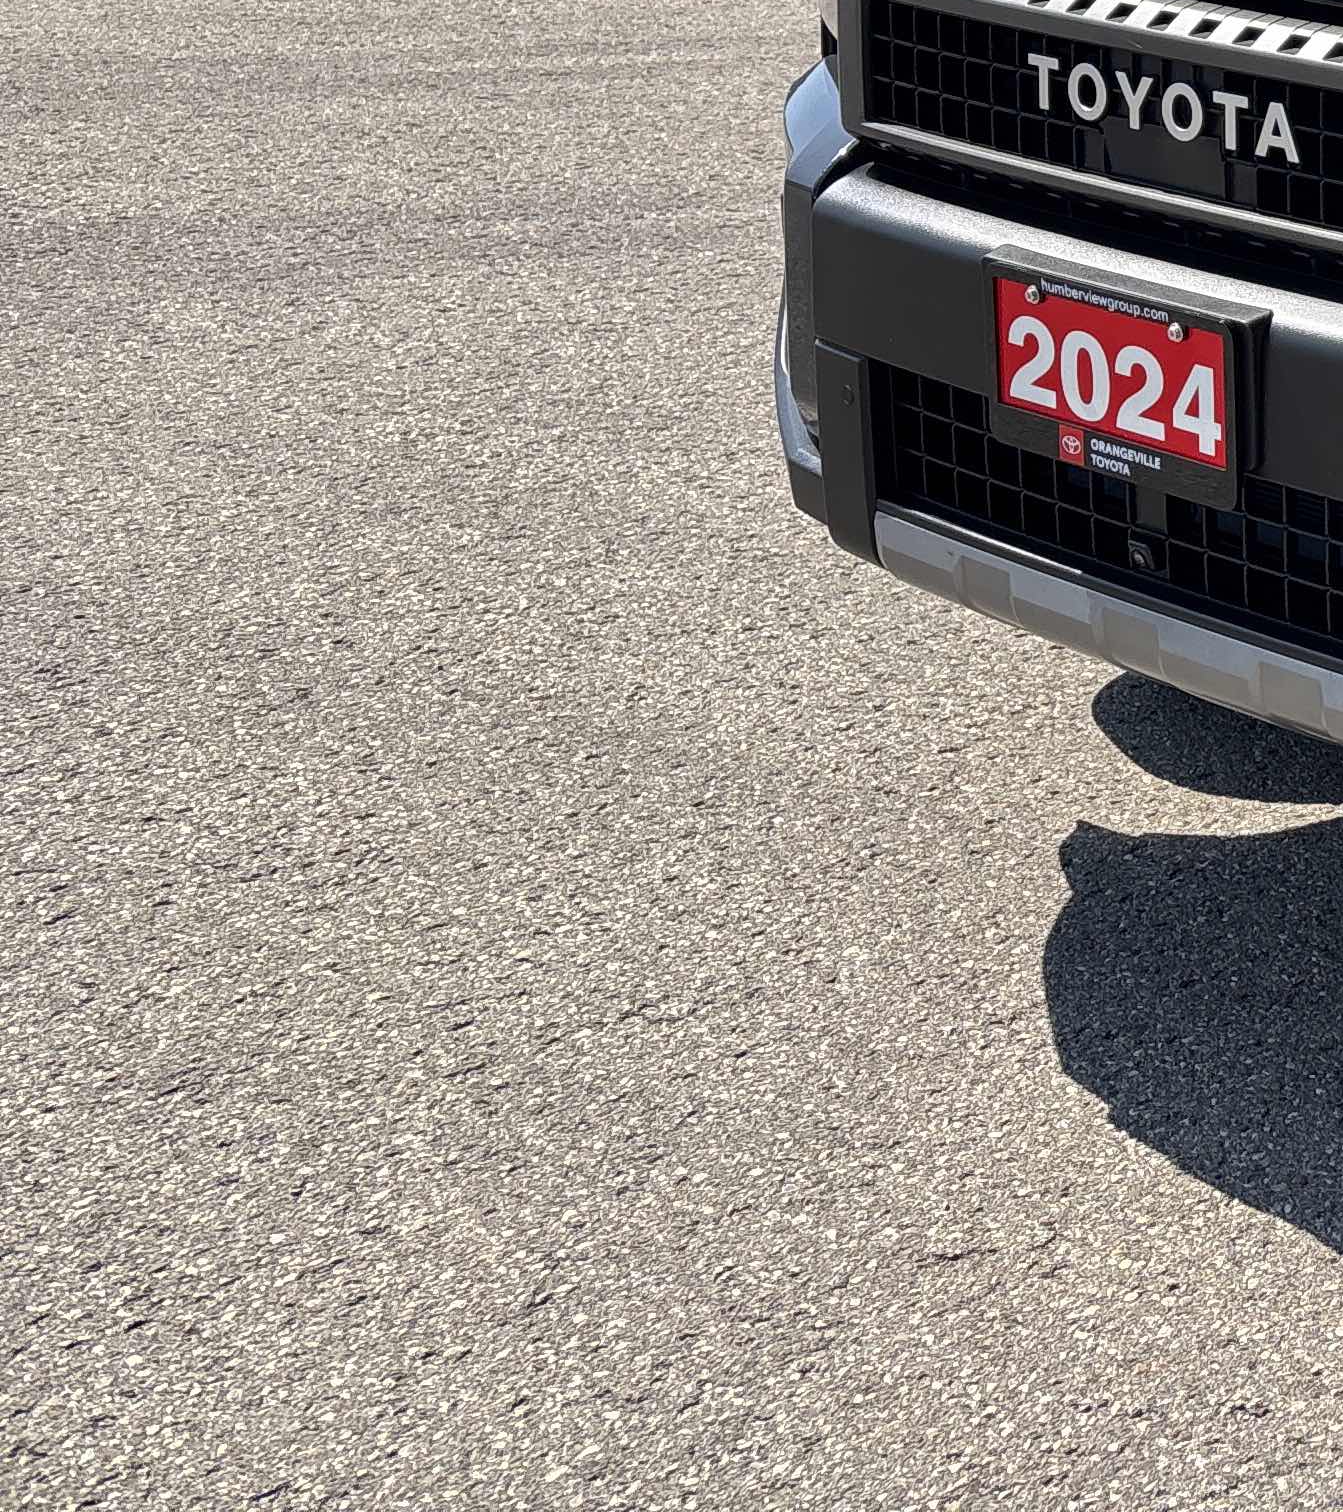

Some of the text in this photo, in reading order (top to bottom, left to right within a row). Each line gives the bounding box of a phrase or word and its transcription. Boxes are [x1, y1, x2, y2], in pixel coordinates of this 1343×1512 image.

[1027, 52, 1301, 164] TOYOTA
[1040, 277, 1170, 323] humberviewgroup.com
[1007, 315, 1222, 457] 2024
[1089, 437, 1162, 470] ORANGEVILLE
[1089, 453, 1132, 477] TOYOTA
